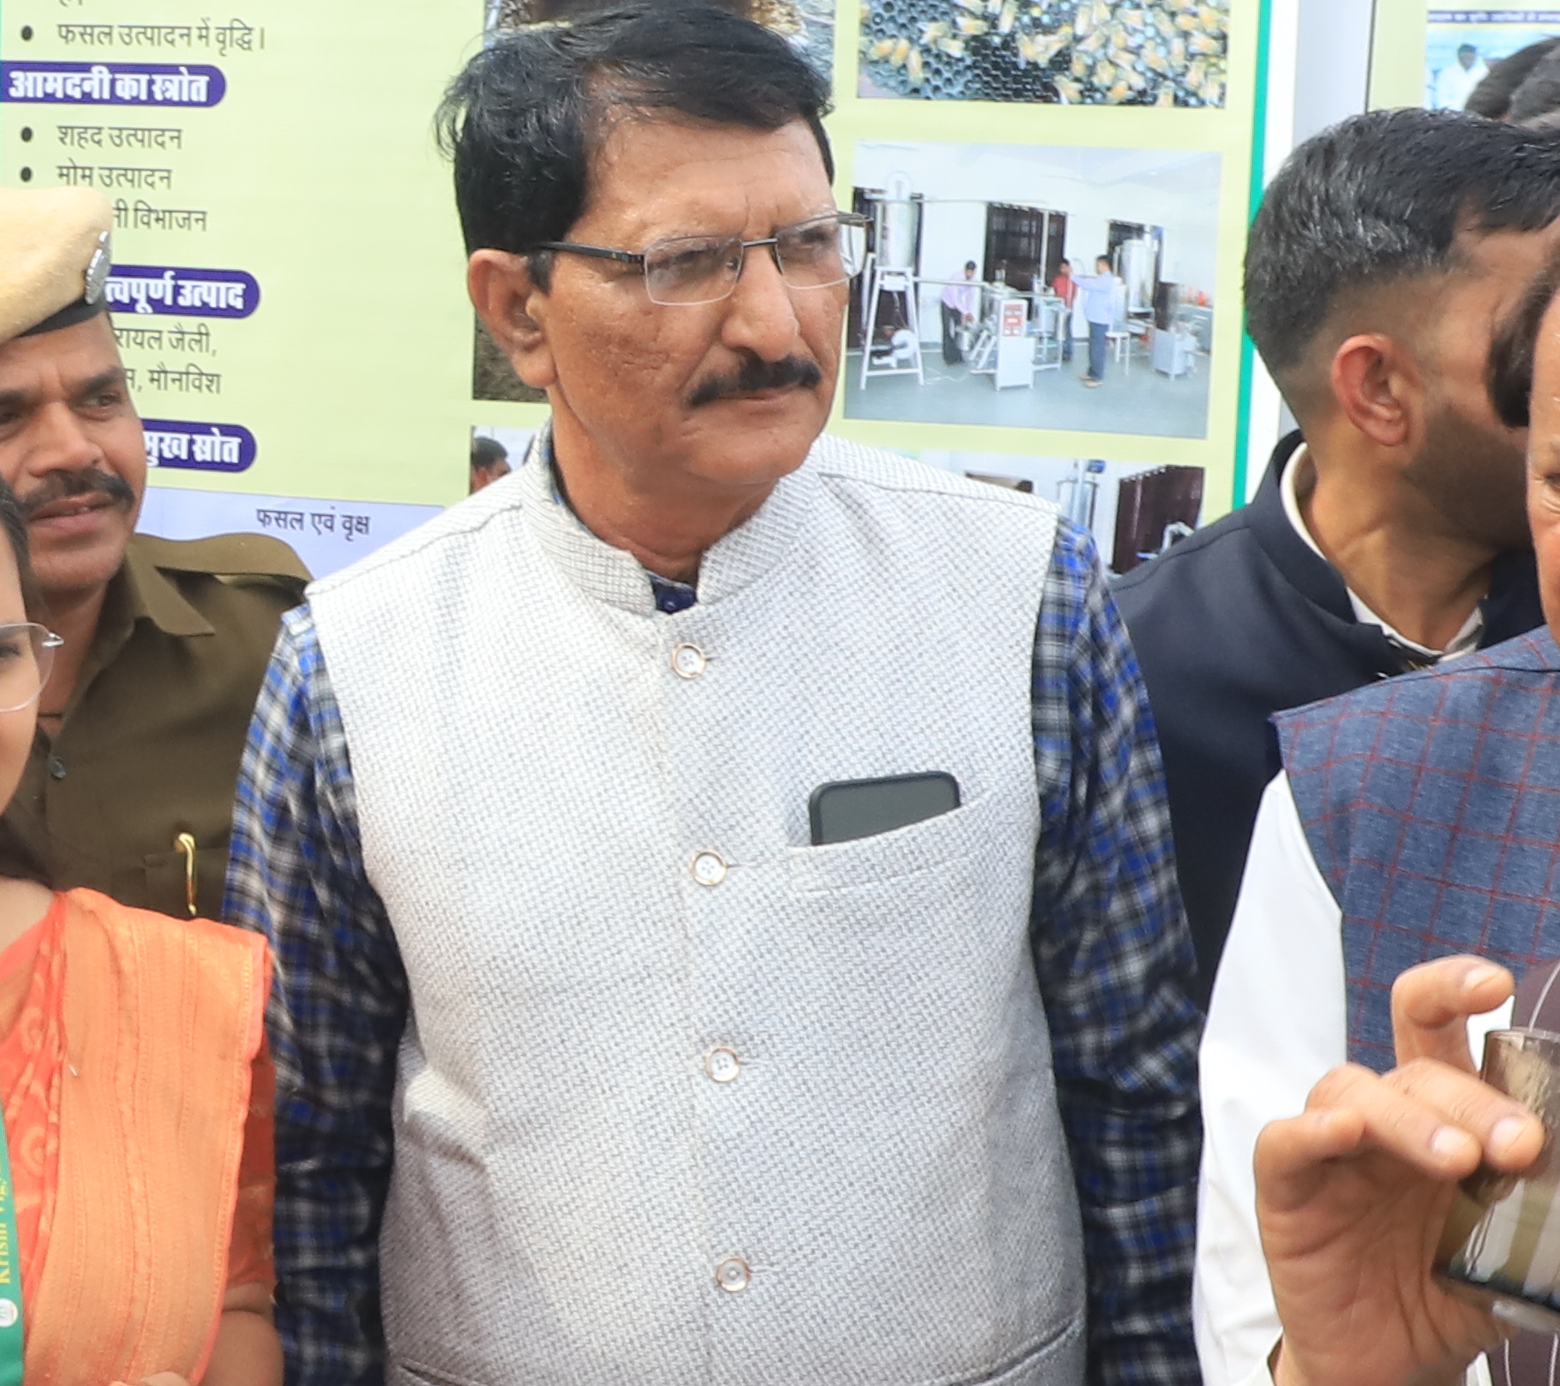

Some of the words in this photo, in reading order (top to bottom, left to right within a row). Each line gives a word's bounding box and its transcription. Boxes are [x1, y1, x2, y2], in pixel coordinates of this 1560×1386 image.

[105, 271, 175, 314] त्वपूर्ण
[177, 280, 246, 310] उत्पाद
[256, 506, 305, 533] फसल
[311, 503, 336, 535] एवं
[342, 513, 371, 542] वृक्ष
